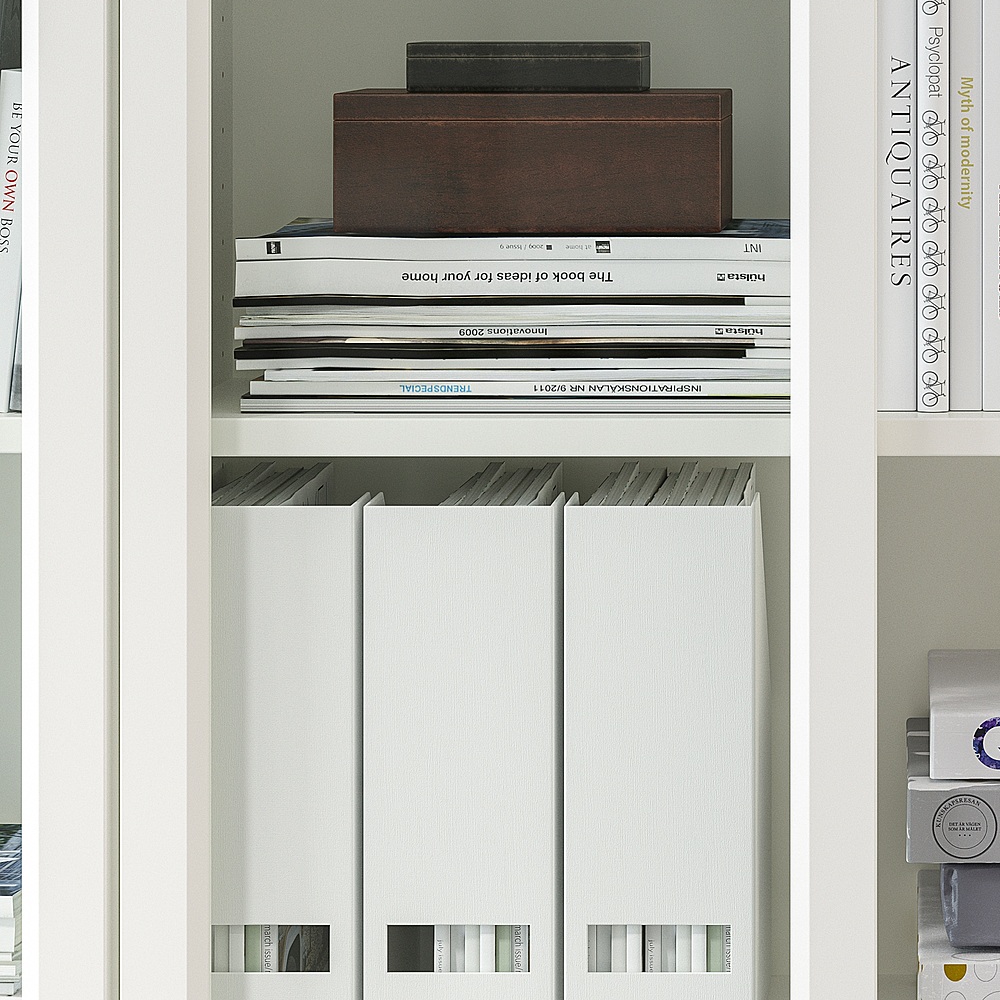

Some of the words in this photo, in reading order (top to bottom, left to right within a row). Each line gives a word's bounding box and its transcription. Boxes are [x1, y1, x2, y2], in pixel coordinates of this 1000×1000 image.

[925, 27, 944, 98] Psyclopat
[958, 77, 974, 112] Myth
[960, 117, 974, 132] of
[7, 124, 22, 165] YOUR
[885, 56, 912, 286] ANTIQUAIRES
[958, 136, 974, 209] modernity
[2, 169, 19, 212] OWN
[743, 243, 762, 253] INT
[402, 272, 438, 282] home
[441, 271, 472, 282] your
[474, 271, 494, 282] for
[496, 271, 532, 282] ideas
[535, 271, 549, 282] of
[552, 271, 585, 282] book
[589, 271, 613, 282] The
[727, 273, 766, 282] hülsta
[458, 328, 485, 336] 2009
[487, 327, 548, 336] Innovations
[725, 327, 763, 335] hülsta
[399, 384, 472, 393] TRENDSPECIAL
[533, 384, 567, 392] 9/2011
[570, 384, 585, 392] NR
[589, 384, 702, 393] INSPIRATIONSKÄLAN
[936, 798, 981, 828] KUNSKAPSRESAN
[263, 925, 271, 950] march
[515, 925, 524, 947] march
[436, 939, 444, 953] july
[647, 939, 655, 953] july
